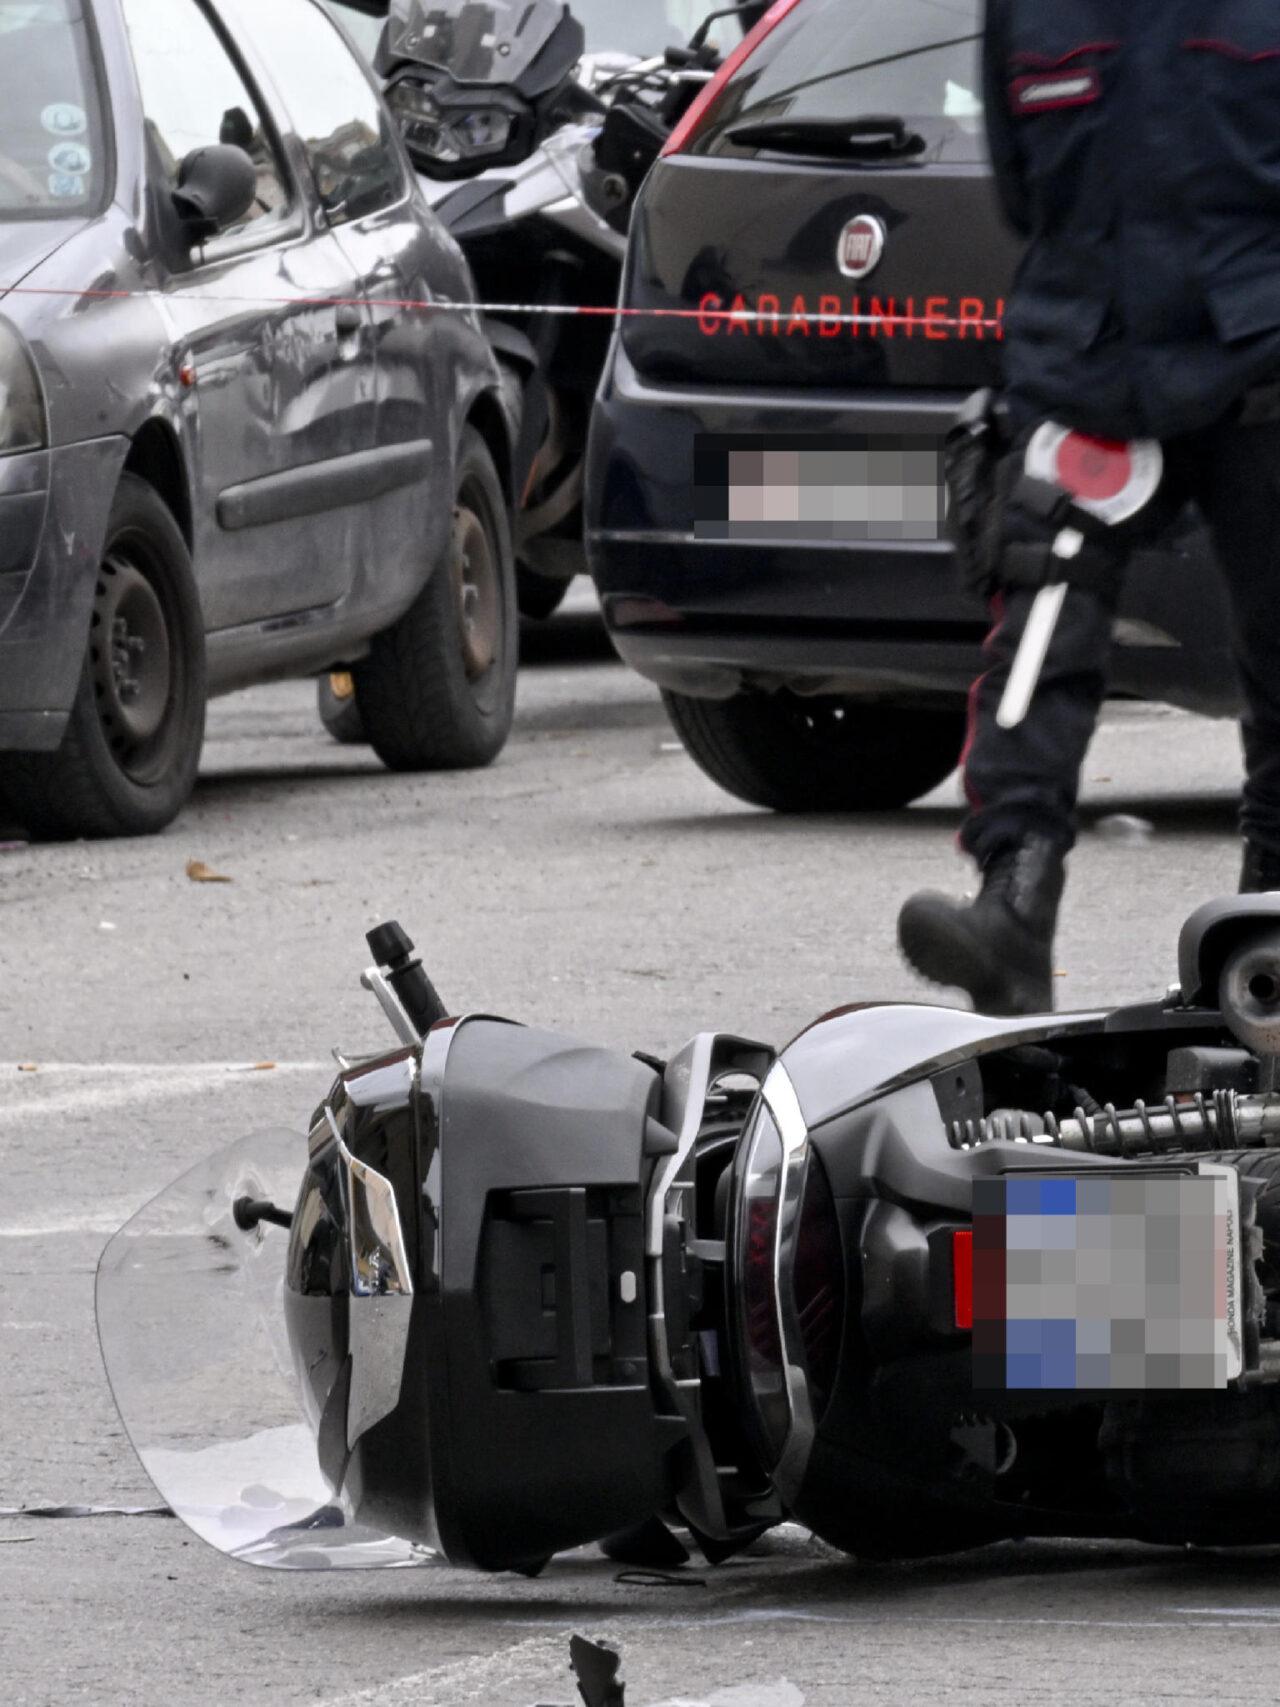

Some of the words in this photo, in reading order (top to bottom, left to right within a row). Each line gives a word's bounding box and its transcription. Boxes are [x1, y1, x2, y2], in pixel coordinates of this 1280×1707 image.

[697, 292, 1005, 341] CARABINIERI
[1225, 1247, 1235, 1298] MAGAZINE
[1226, 1300, 1236, 1335] HONDA
